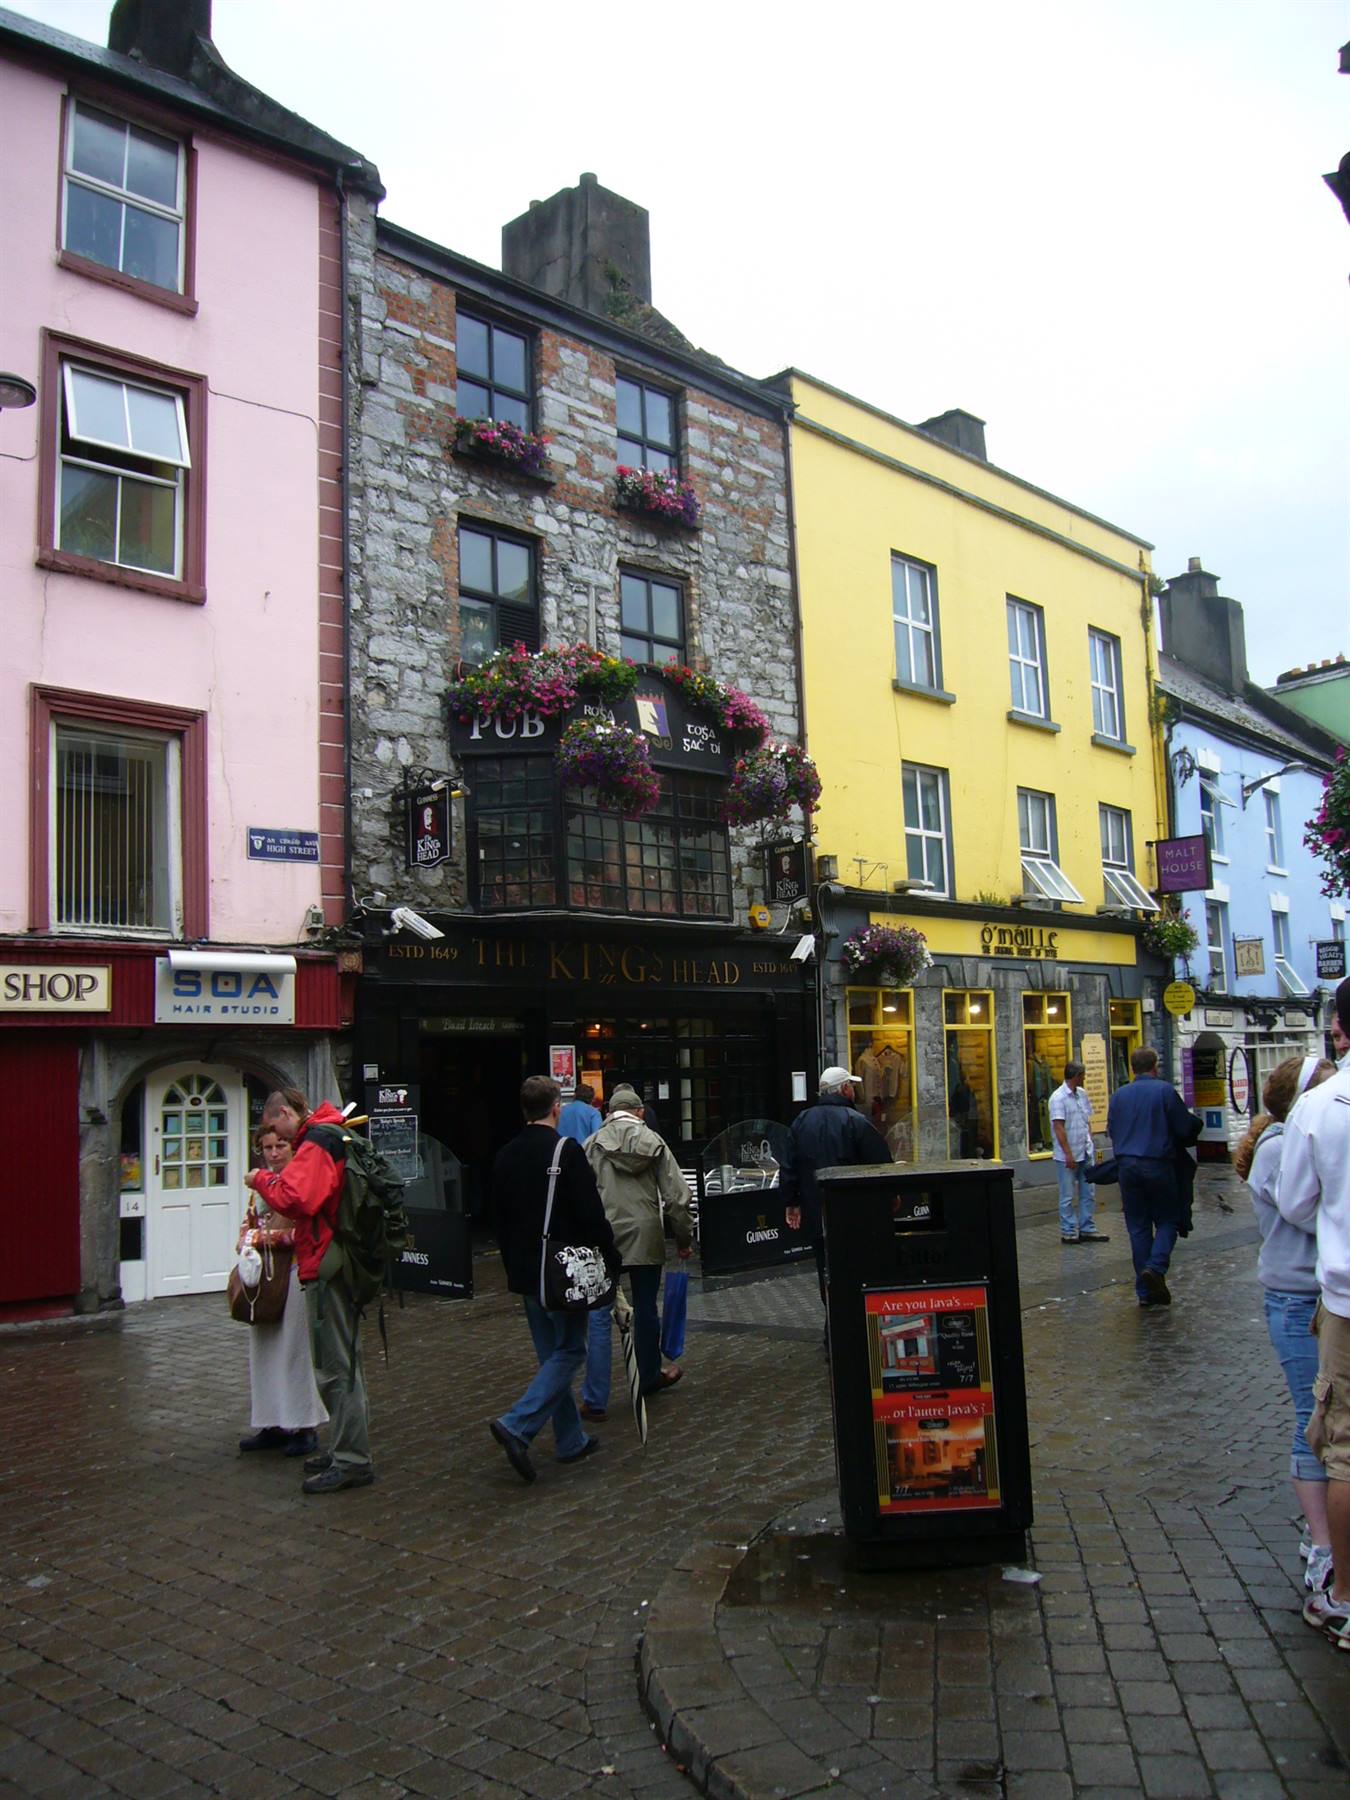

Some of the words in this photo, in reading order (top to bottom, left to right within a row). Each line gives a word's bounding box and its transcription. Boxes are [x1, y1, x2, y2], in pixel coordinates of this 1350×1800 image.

[470, 711, 545, 740] PUB
[266, 845, 287, 854] HIGH
[289, 846, 317, 856] STREET
[416, 849, 440, 862] HEAD
[1165, 846, 1197, 859] MALT
[1161, 860, 1204, 875] HOUSE
[775, 888, 799, 899] HEAD
[387, 944, 425, 959] ESTD
[429, 945, 459, 960] 1649
[473, 937, 536, 968] THE
[672, 960, 741, 986] HEAD
[1317, 959, 1344, 967] BARBER
[750, 962, 777, 975] ESTD
[1320, 966, 1341, 974] SHOP
[4, 973, 99, 1002] SHOP
[173, 970, 280, 998] SOA
[172, 1004, 213, 1014] HAIR
[221, 1005, 280, 1015] STUDIO
[1235, 1091, 1246, 1100] SHOP
[125, 1201, 139, 1211] 14
[745, 1228, 780, 1244] GUINNESS
[881, 1300, 903, 1312] Are
[904, 1301, 927, 1313] you
[929, 1297, 961, 1309] Java's
[959, 1374, 974, 1383] 7/7
[893, 1409, 906, 1419] or
[908, 1405, 944, 1418] l'autre
[947, 1403, 978, 1416] Java's
